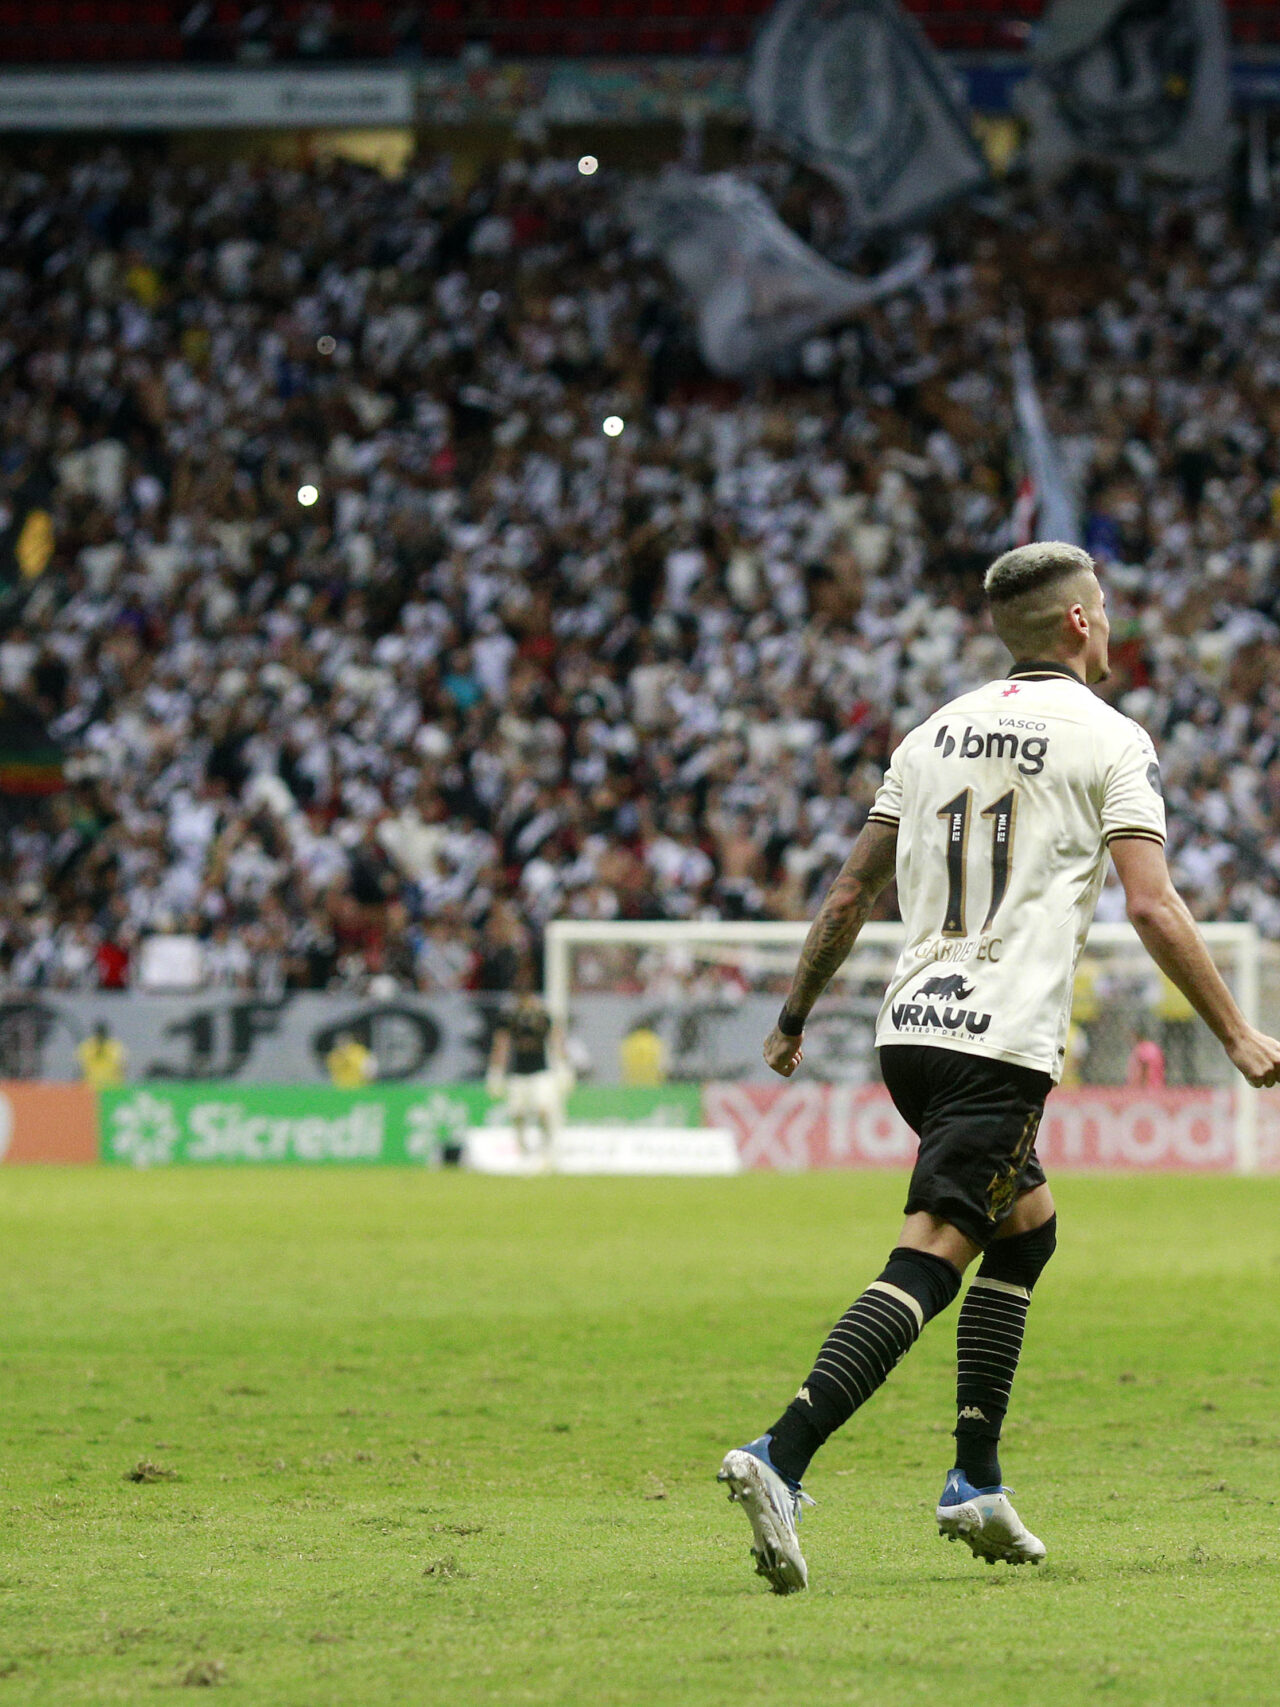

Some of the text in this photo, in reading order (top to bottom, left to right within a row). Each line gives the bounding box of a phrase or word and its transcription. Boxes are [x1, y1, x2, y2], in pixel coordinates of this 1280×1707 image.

[998, 718, 1047, 732] VASCO
[960, 726, 1049, 775] bmg
[953, 813, 963, 831] TIM
[998, 813, 1008, 832] TIM
[936, 786, 1019, 938] 11
[942, 1028, 986, 1043] DRINK
[187, 1102, 388, 1161] Sicredi
